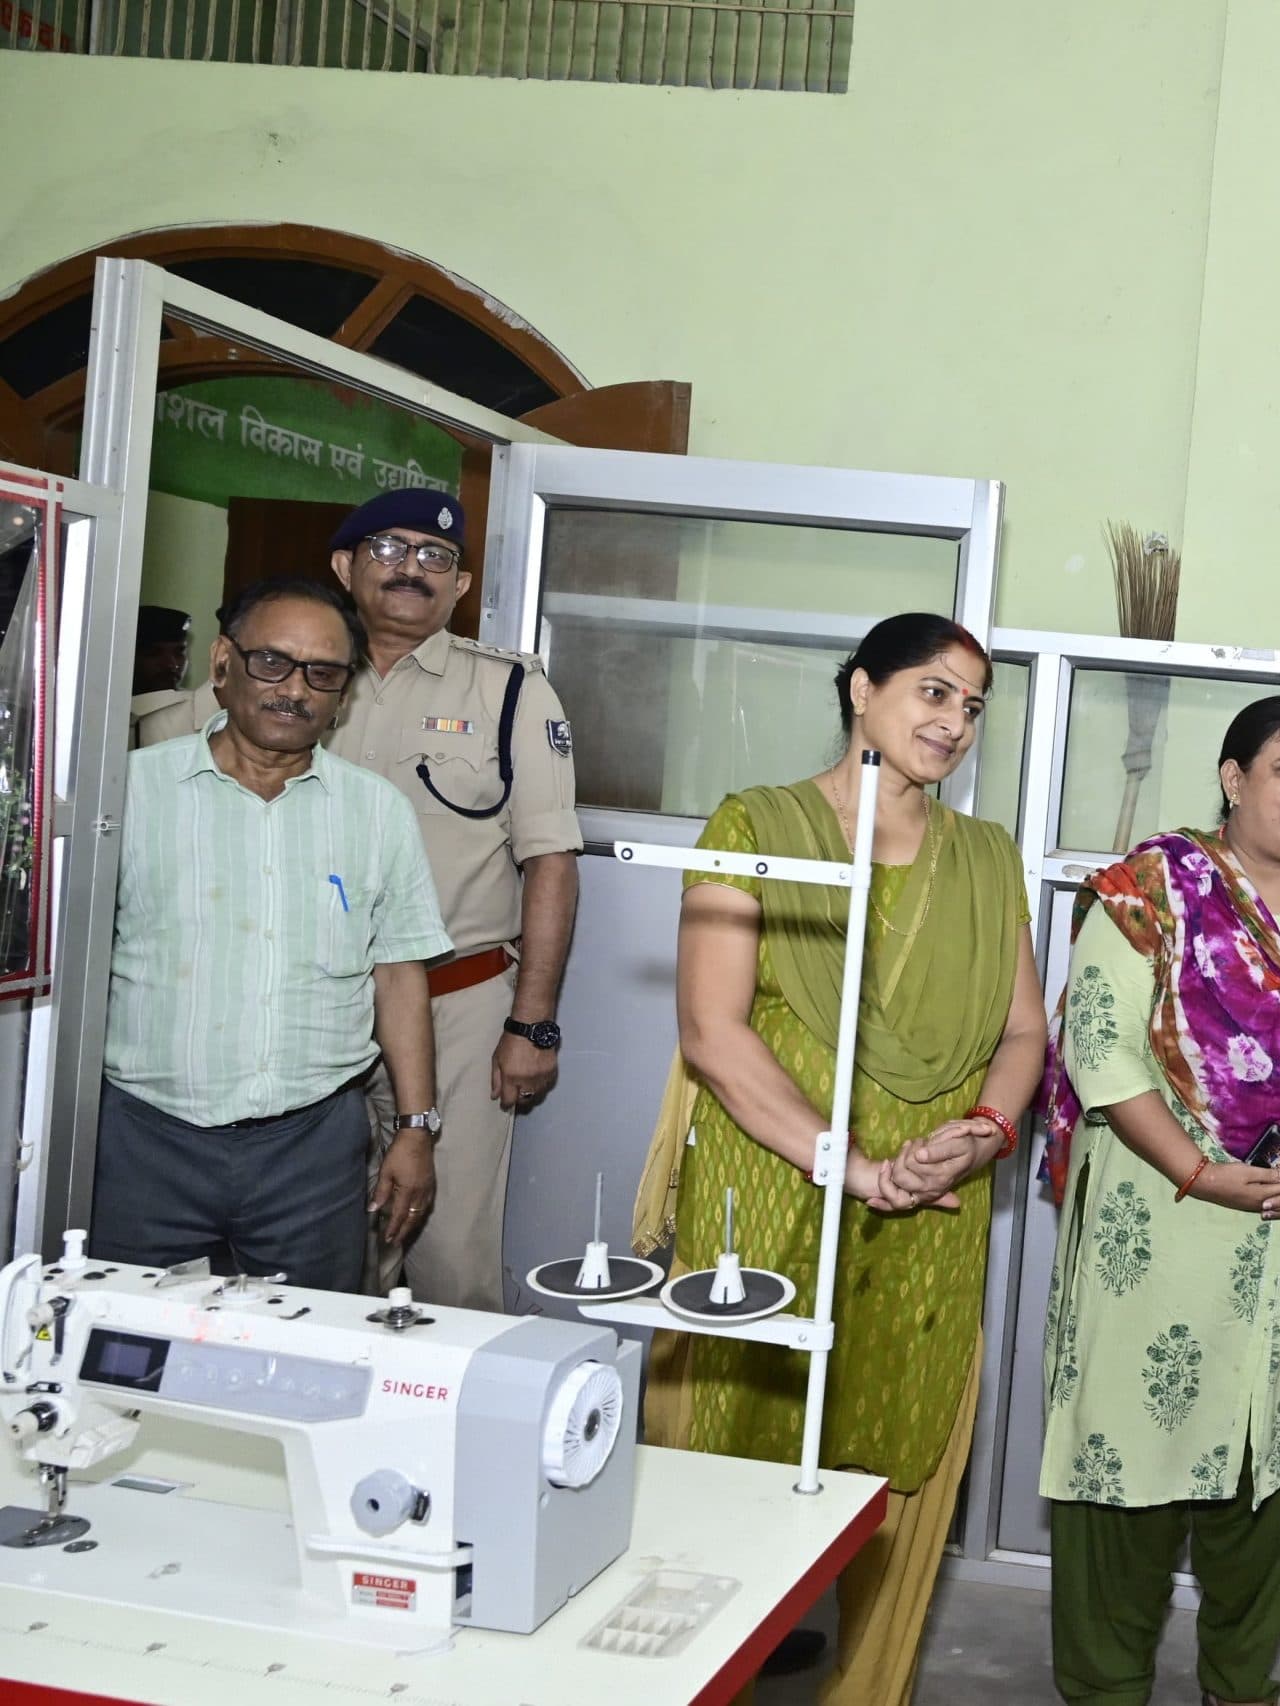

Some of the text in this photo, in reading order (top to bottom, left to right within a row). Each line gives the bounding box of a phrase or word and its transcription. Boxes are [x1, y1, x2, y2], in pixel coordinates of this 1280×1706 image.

[240, 405, 323, 467] विकास
[329, 443, 364, 480] एवं
[382, 1379, 449, 1401] SINGER
[362, 1575, 409, 1591] SINGER
